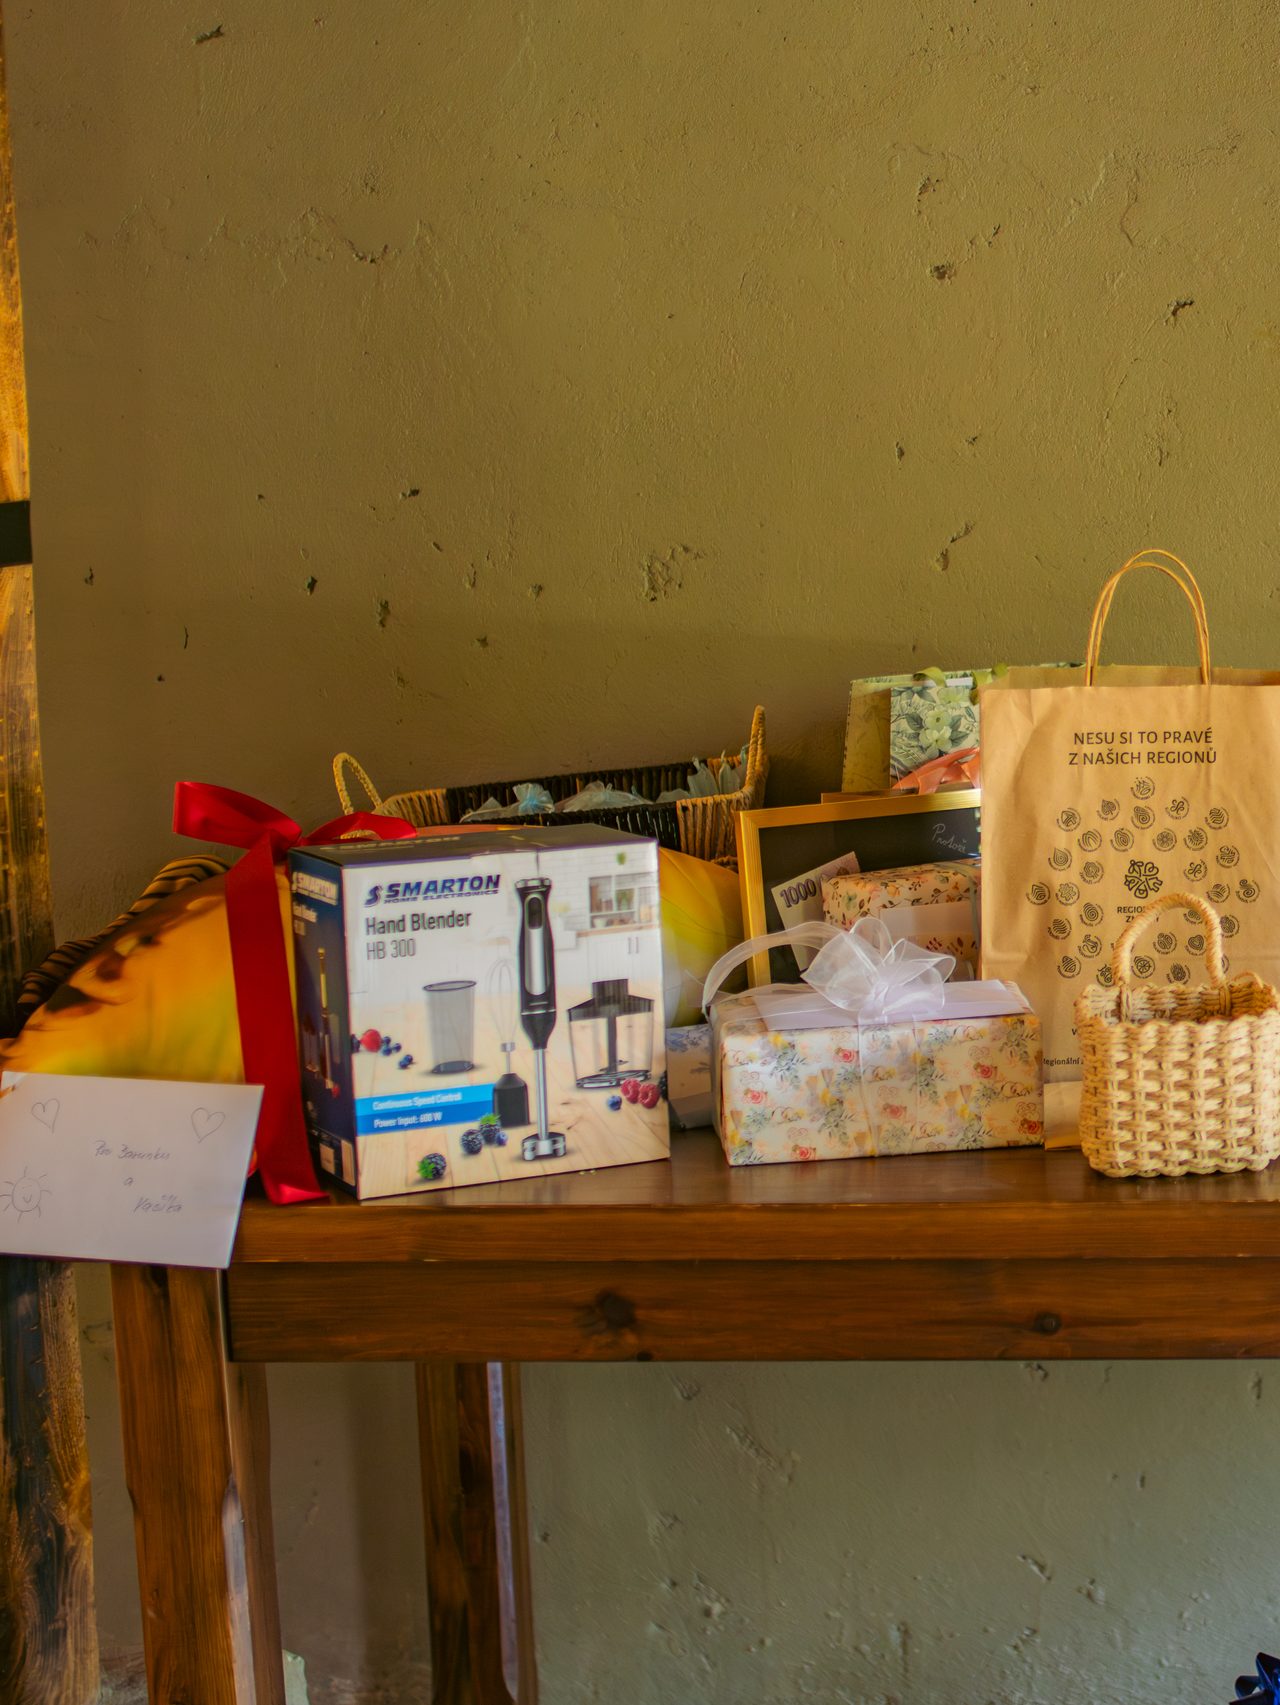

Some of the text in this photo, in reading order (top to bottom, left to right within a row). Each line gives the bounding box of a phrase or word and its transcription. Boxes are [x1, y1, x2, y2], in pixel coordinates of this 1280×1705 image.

[1074, 727, 1213, 745] NESU SI TO PRAVÉ
[1068, 747, 1217, 765] Z NAŠICH REGIONŮ
[385, 874, 501, 899] SMARTON
[422, 889, 499, 901] ELECTRONICS
[779, 879, 818, 908] 1000
[365, 910, 472, 936] Hand Blender
[366, 938, 417, 961] HB 300
[374, 1118, 396, 1129] Power
[123, 1176, 135, 1187] a
